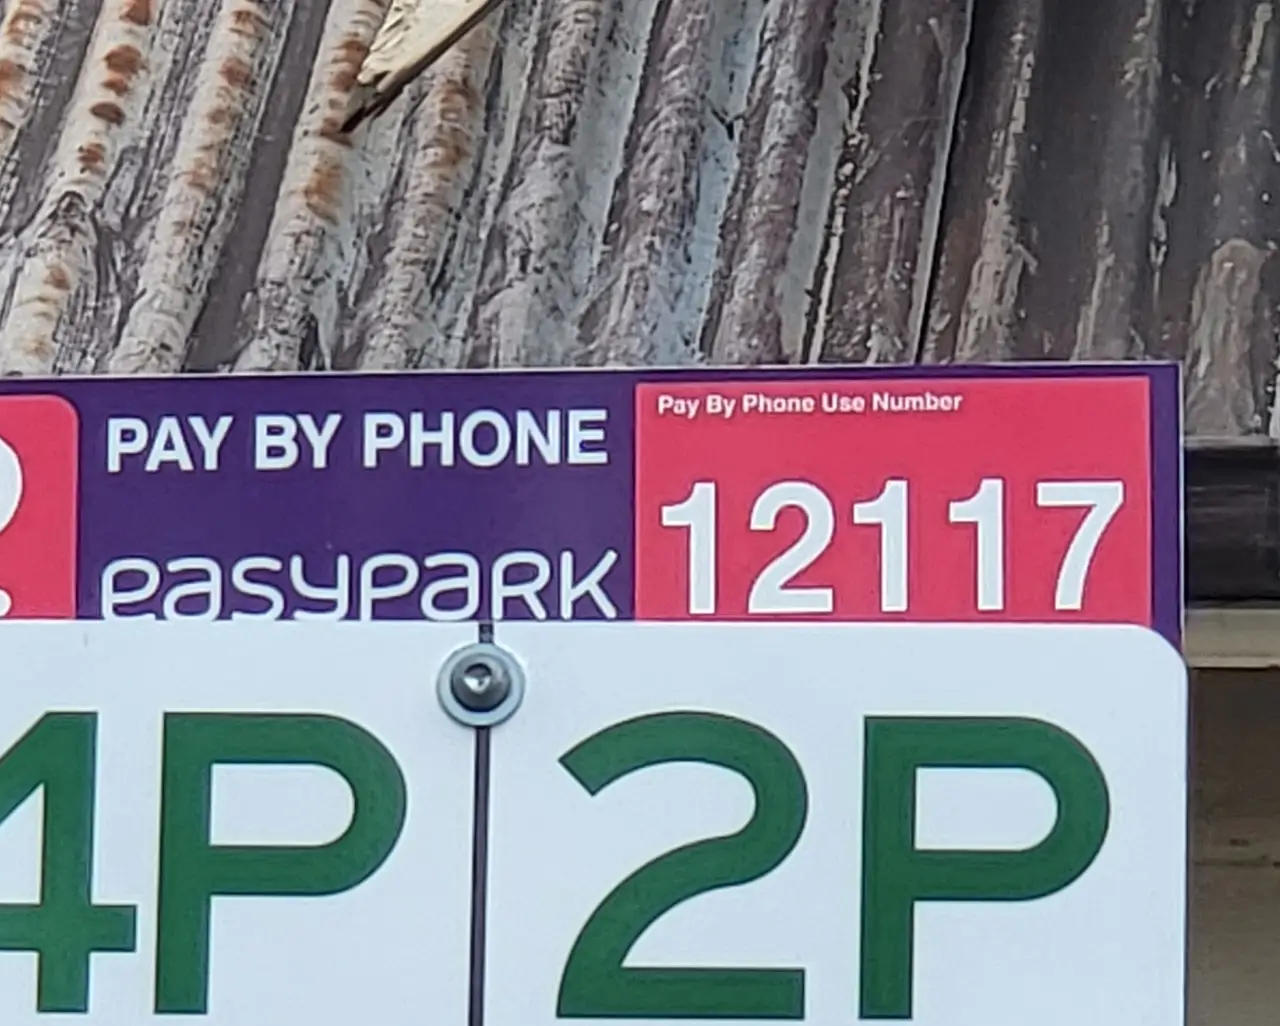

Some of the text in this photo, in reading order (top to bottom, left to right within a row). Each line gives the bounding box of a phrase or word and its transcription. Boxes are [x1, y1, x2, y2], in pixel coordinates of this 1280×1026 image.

[106, 408, 609, 474] PAY BY PHONE
[657, 391, 964, 420] Pay By Phone Use Number
[660, 477, 1125, 616] 12117
[554, 709, 1112, 1022] 2P
